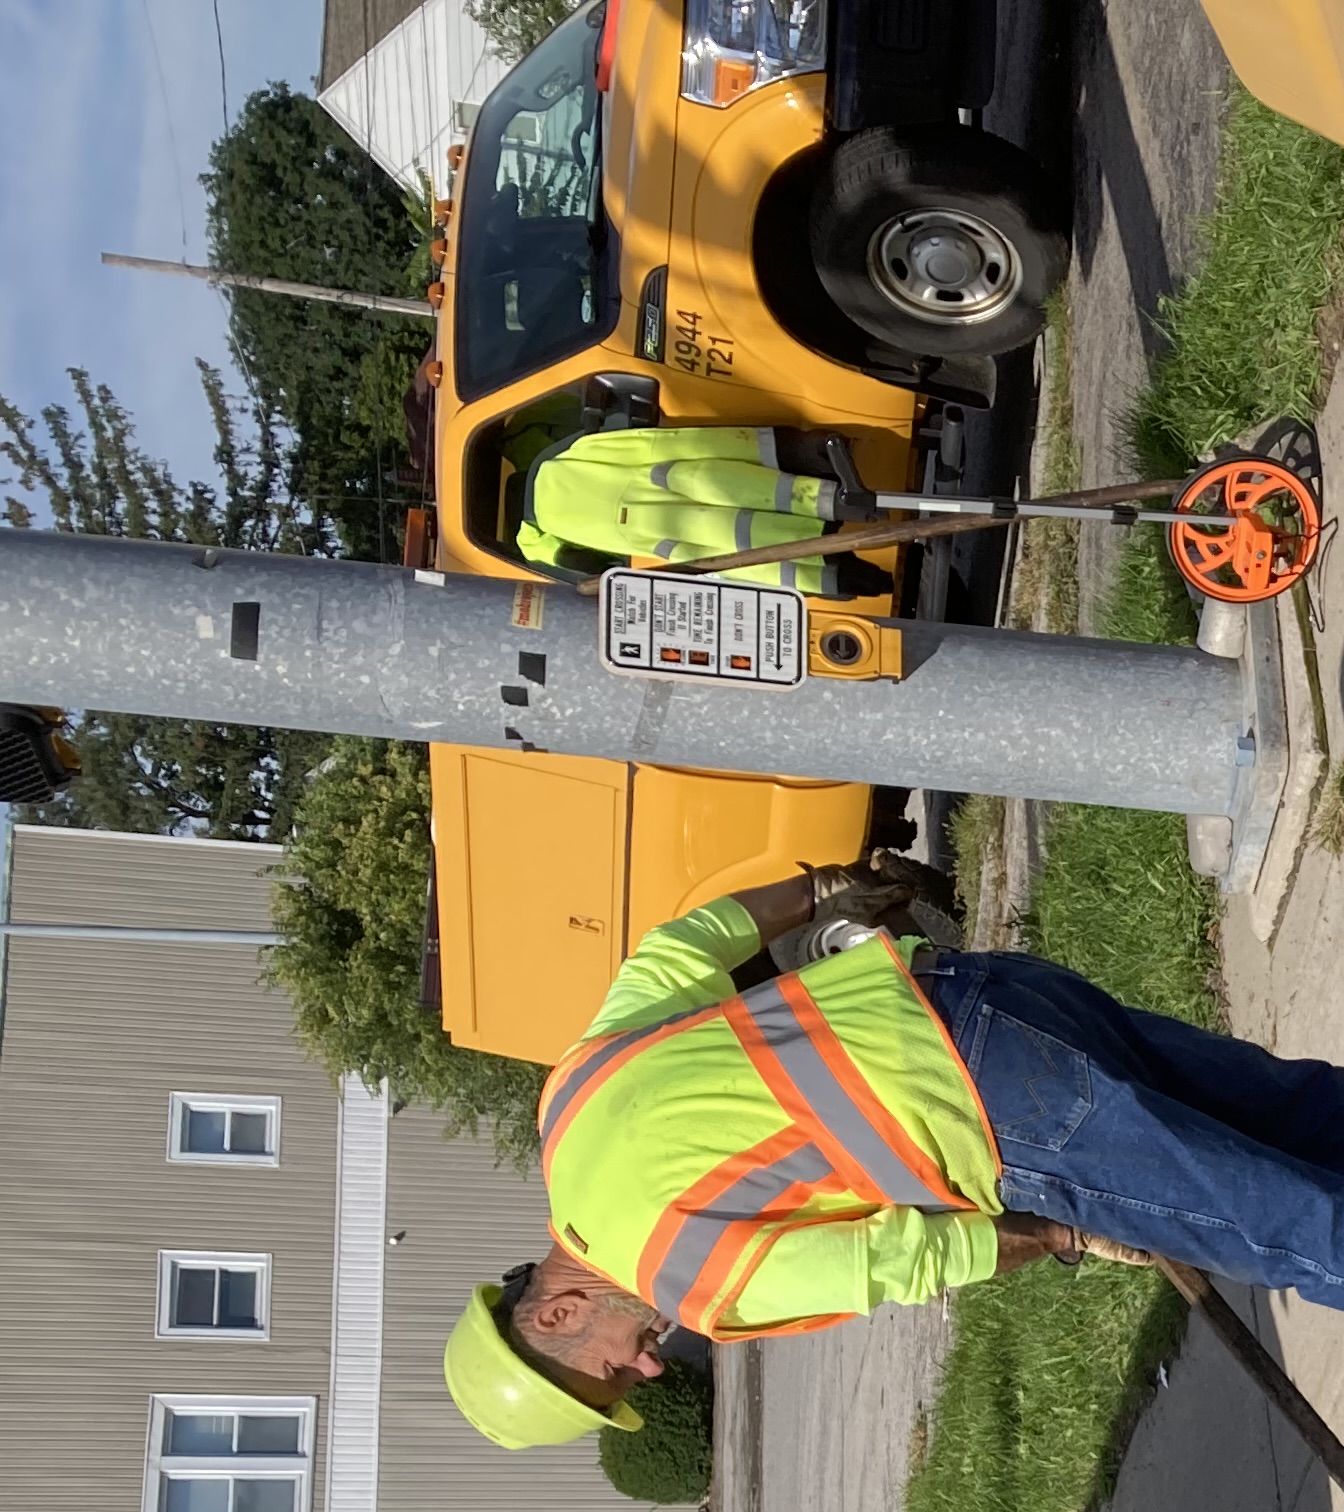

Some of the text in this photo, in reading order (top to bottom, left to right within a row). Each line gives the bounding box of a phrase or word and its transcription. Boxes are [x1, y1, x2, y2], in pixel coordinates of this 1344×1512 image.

[675, 309, 702, 372] 4944
[706, 336, 734, 377] T21
[614, 583, 625, 634] START CROSSING
[765, 610, 774, 662] PUSH BUTTON
[783, 619, 792, 657] TO CROSS
